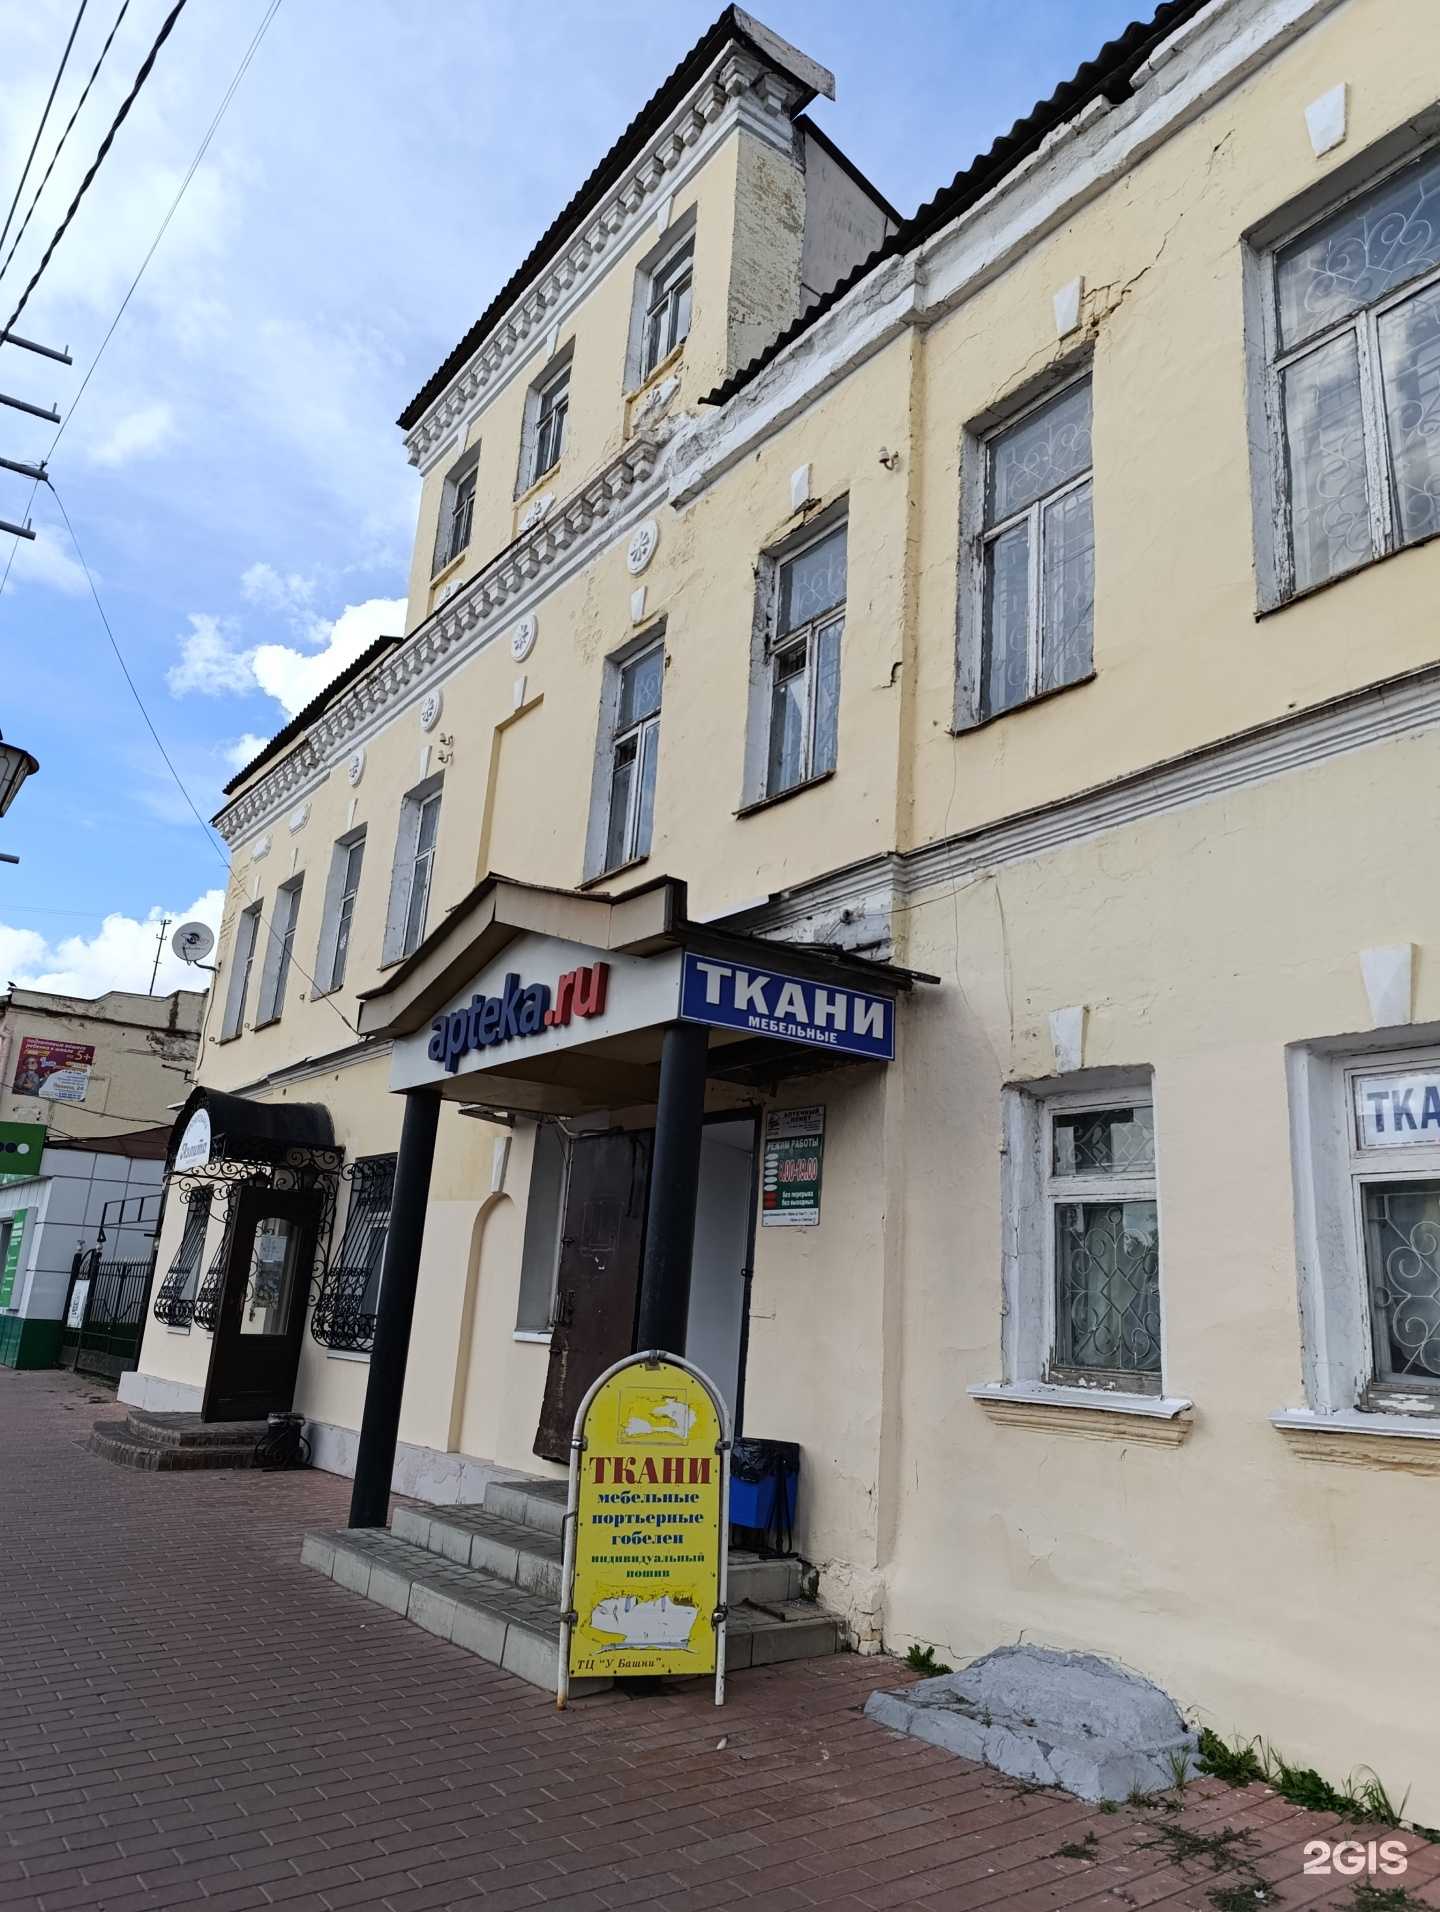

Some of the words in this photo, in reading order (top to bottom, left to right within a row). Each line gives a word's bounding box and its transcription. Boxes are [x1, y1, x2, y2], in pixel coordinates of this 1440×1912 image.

[696, 962, 885, 1040] ТКАНИ
[428, 962, 610, 1074] apteka.ru
[748, 1015, 838, 1044] МЕБЕЛЬНЫЕ
[791, 1137, 819, 1149] РАБОТЫ
[589, 1456, 712, 1485] ТКАНИ
[597, 1490, 700, 1504] мебельные
[592, 1513, 704, 1527] портьерные
[612, 1531, 684, 1545] гобелен
[591, 1552, 705, 1565] индивидуальный
[626, 1569, 670, 1578] пошив
[577, 1659, 596, 1671] ТЦ
